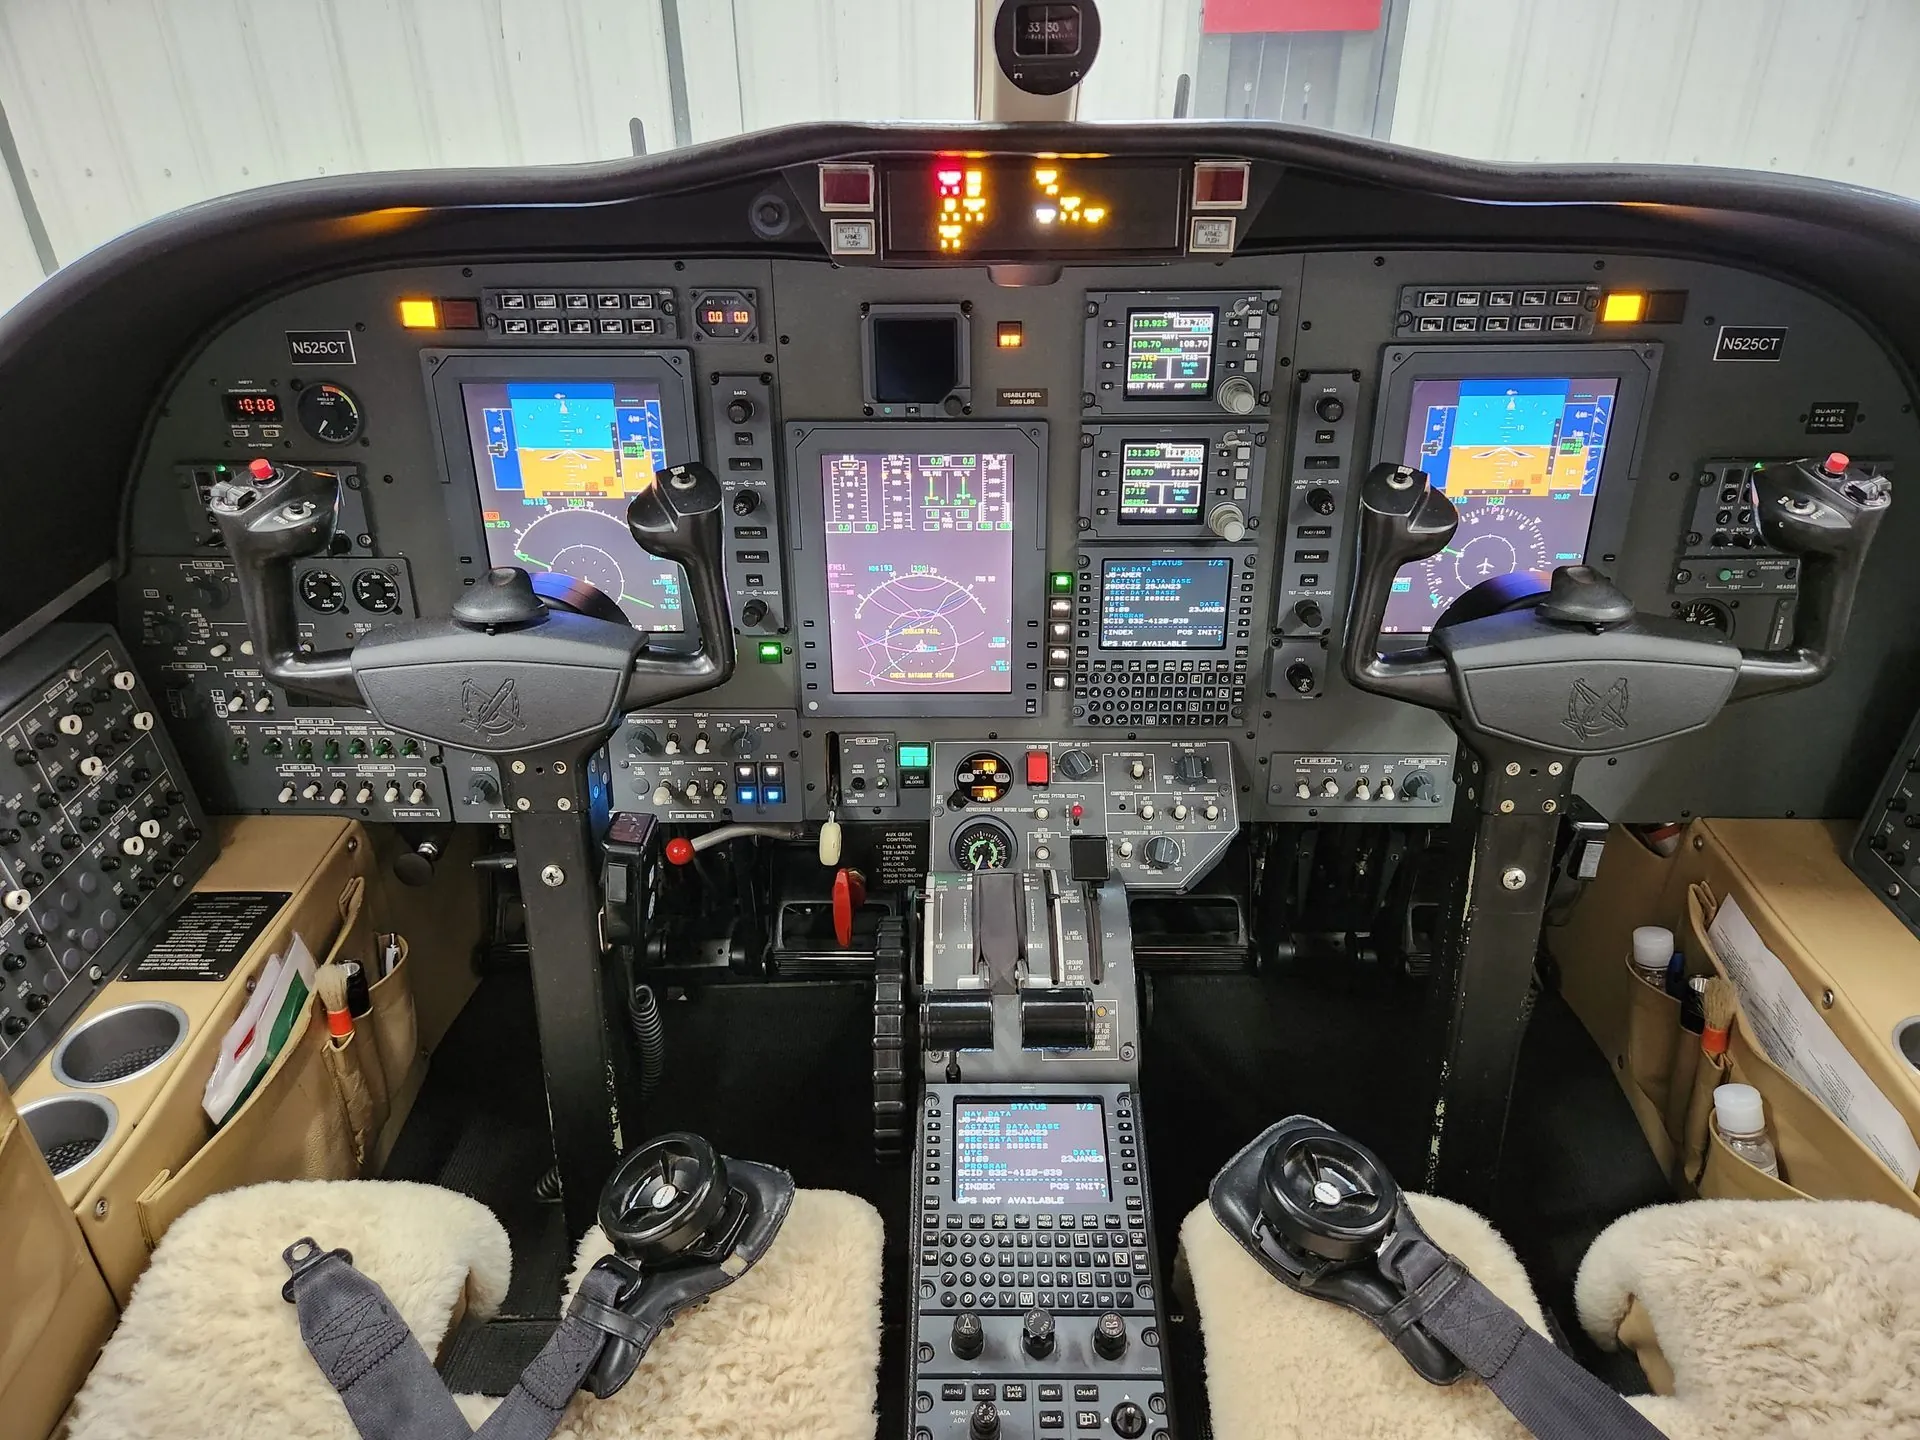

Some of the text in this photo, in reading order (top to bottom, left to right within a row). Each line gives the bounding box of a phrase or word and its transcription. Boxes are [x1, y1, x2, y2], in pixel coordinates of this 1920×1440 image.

[1028, 22, 1040, 32] 33
[292, 342, 346, 354] N525CT
[1132, 340, 1208, 348] 108.70 108.70
[1722, 338, 1780, 350] N525CT
[964, 1235, 971, 1243] 2
[983, 1235, 990, 1244] 3
[1002, 1235, 1010, 1244] A
[1022, 1235, 1028, 1243] B
[1040, 1235, 1048, 1244] C
[1058, 1235, 1066, 1244] D
[1096, 1235, 1103, 1244] F
[1115, 1235, 1124, 1244] G
[945, 1254, 953, 1263] 4
[964, 1255, 972, 1263] 5
[983, 1254, 991, 1263] 6
[1003, 1254, 1010, 1263] H
[1041, 1254, 1048, 1263] J
[1059, 1254, 1067, 1263] K
[1079, 1254, 1085, 1263] L
[1097, 1254, 1107, 1263] M
[945, 1274, 953, 1282] 7
[964, 1274, 972, 1282] 8
[984, 1274, 991, 1283] 9
[1002, 1274, 1011, 1283] O
[1022, 1274, 1029, 1283] P
[1040, 1274, 1050, 1283] Q
[1061, 1274, 1068, 1283] R
[1100, 1274, 1107, 1283] T
[1119, 1275, 1126, 1283] U
[1003, 1294, 1012, 1303] V
[1043, 1294, 1050, 1304] X
[1062, 1294, 1070, 1303] Y
[1082, 1295, 1090, 1304] Z
